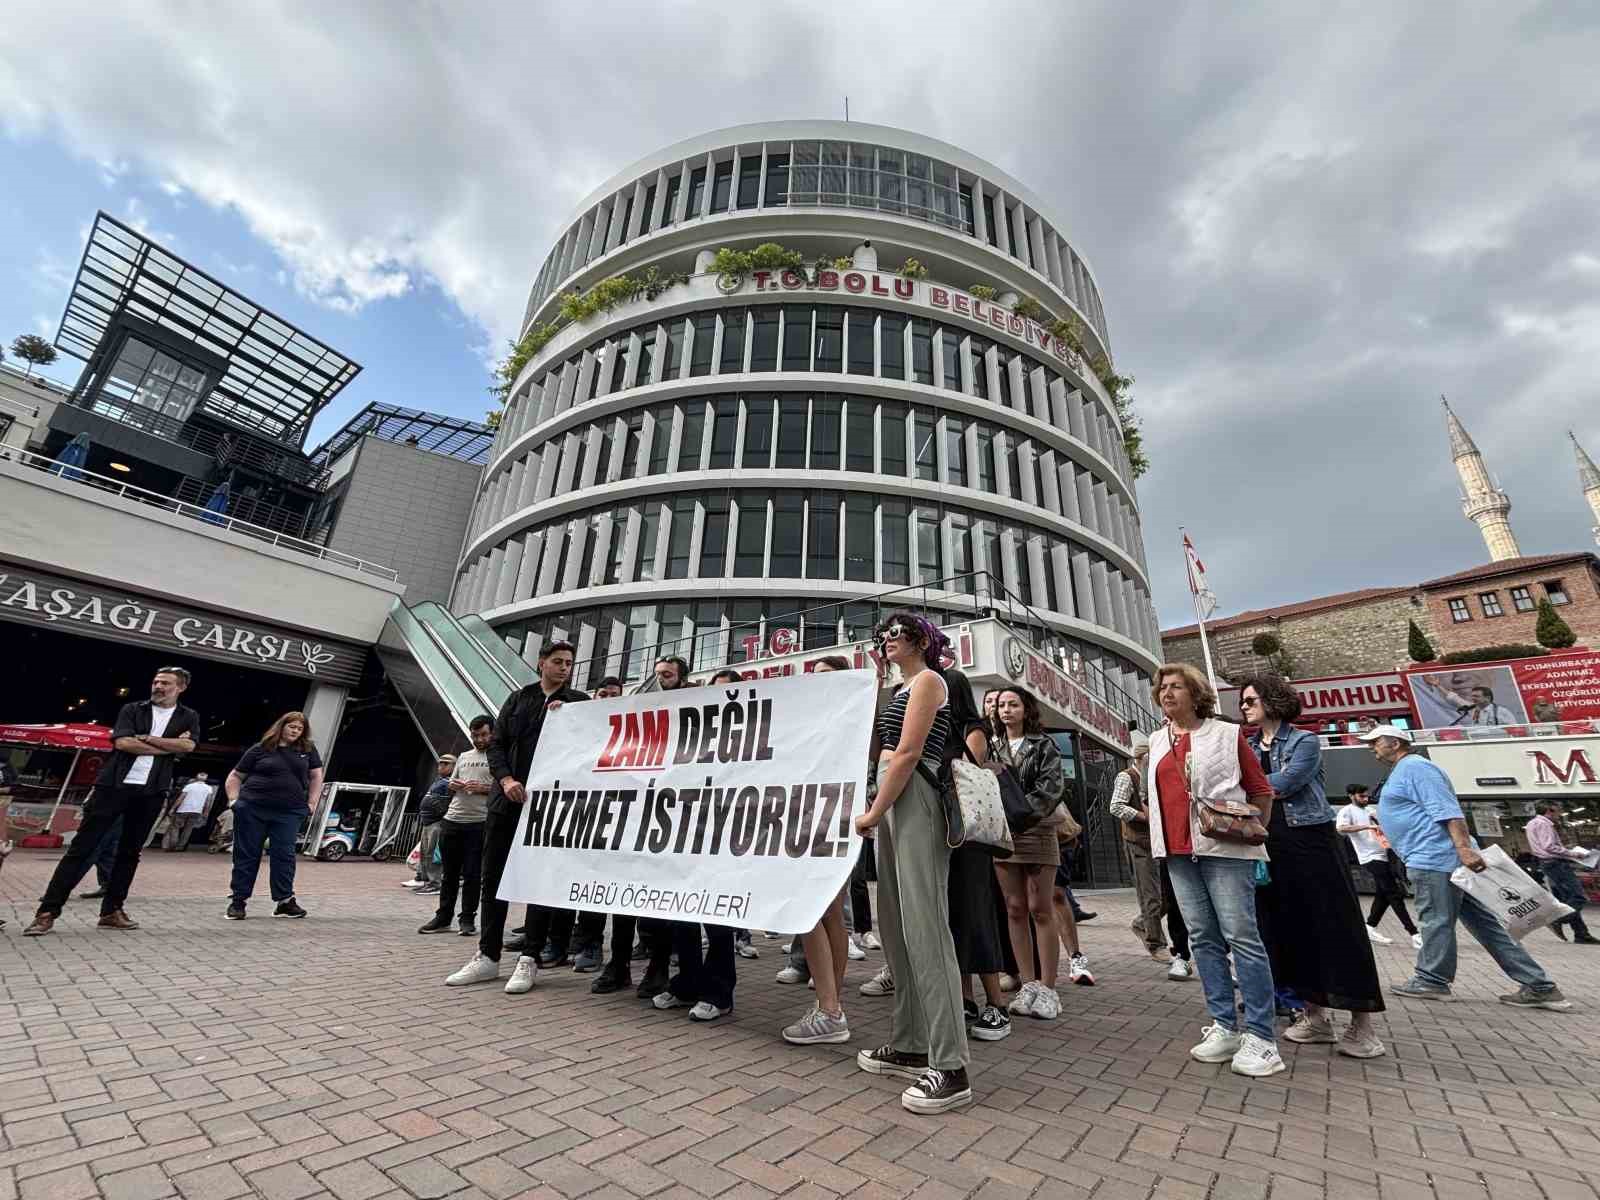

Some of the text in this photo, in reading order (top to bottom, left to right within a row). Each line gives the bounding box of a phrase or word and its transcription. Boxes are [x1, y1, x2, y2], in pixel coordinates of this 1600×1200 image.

[818, 271, 914, 300] BOLU
[3, 581, 292, 662] AŞAĞI ÇARŞI
[742, 626, 801, 662] T.C.
[1521, 682, 1555, 691] EKREM
[1546, 668, 1595, 679] ADAYIMIZ
[1298, 683, 1408, 709] UMHUR
[1552, 687, 1600, 698] ÖZGÜRLÜ
[597, 688, 773, 769] ZAM DEĞİL
[1526, 749, 1600, 785] M
[523, 775, 856, 859] HİZMET İSTİYORUZ!
[569, 880, 751, 920] BAİBÜ ÖĞRENCİLERİ
